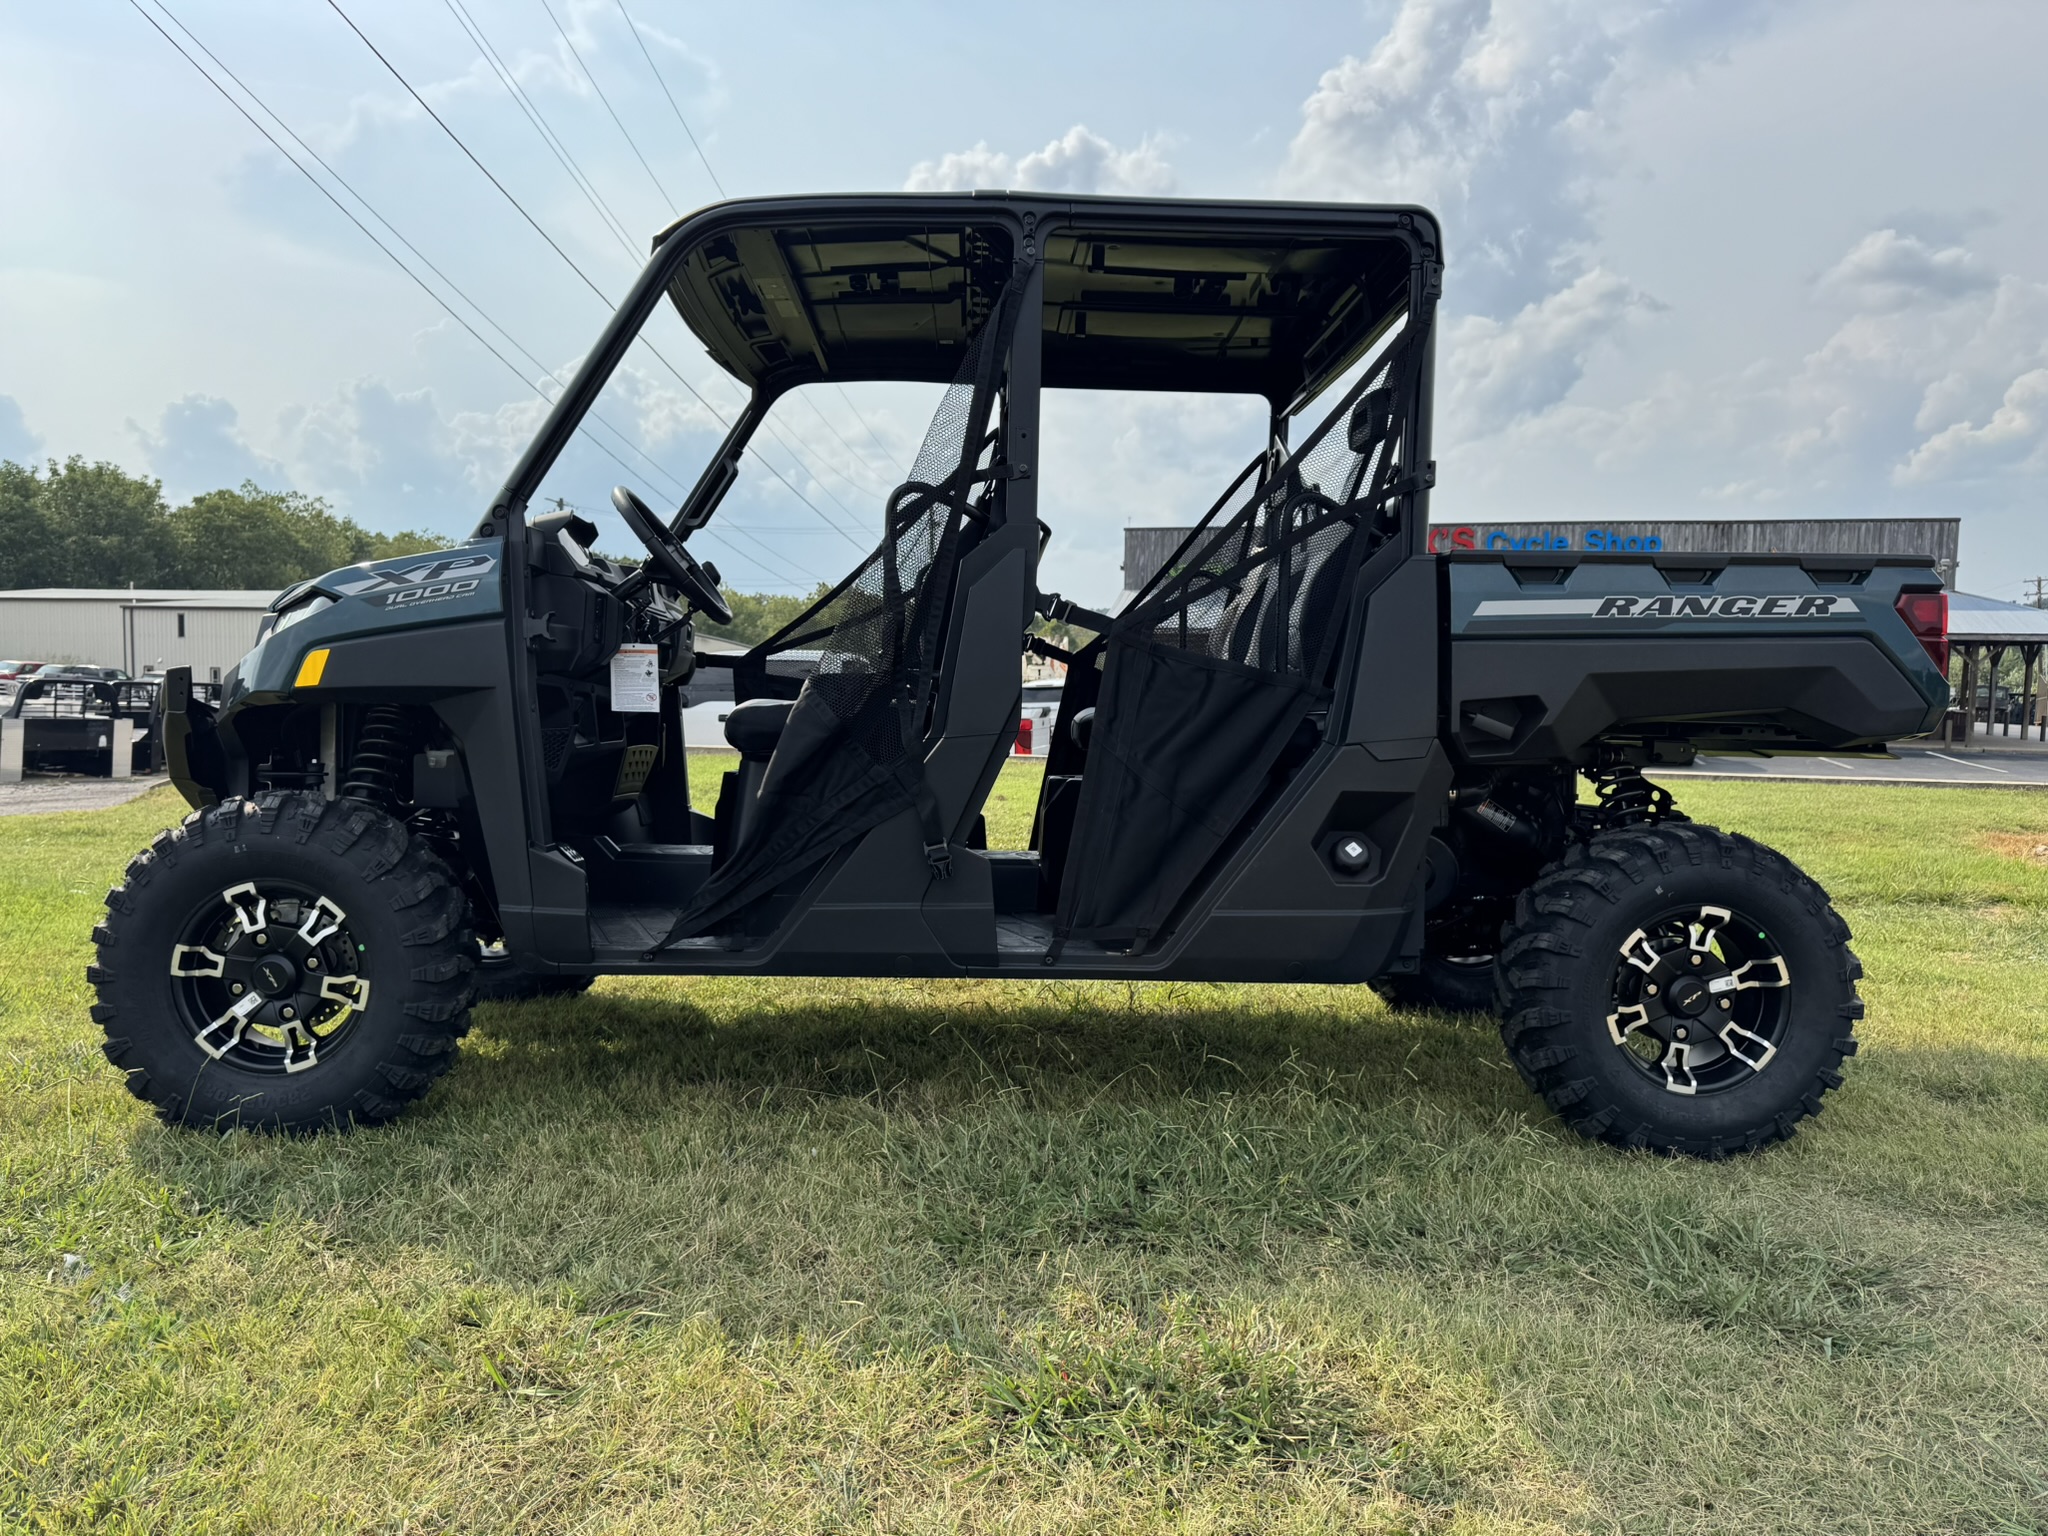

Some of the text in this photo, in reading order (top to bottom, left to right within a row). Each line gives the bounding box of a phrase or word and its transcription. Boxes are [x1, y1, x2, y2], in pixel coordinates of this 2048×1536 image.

[1486, 531, 1570, 551] Cycle
[1584, 529, 1663, 552] Shop
[358, 554, 495, 594] XP
[386, 580, 480, 604] 1000
[1592, 595, 1839, 618] RANGER
